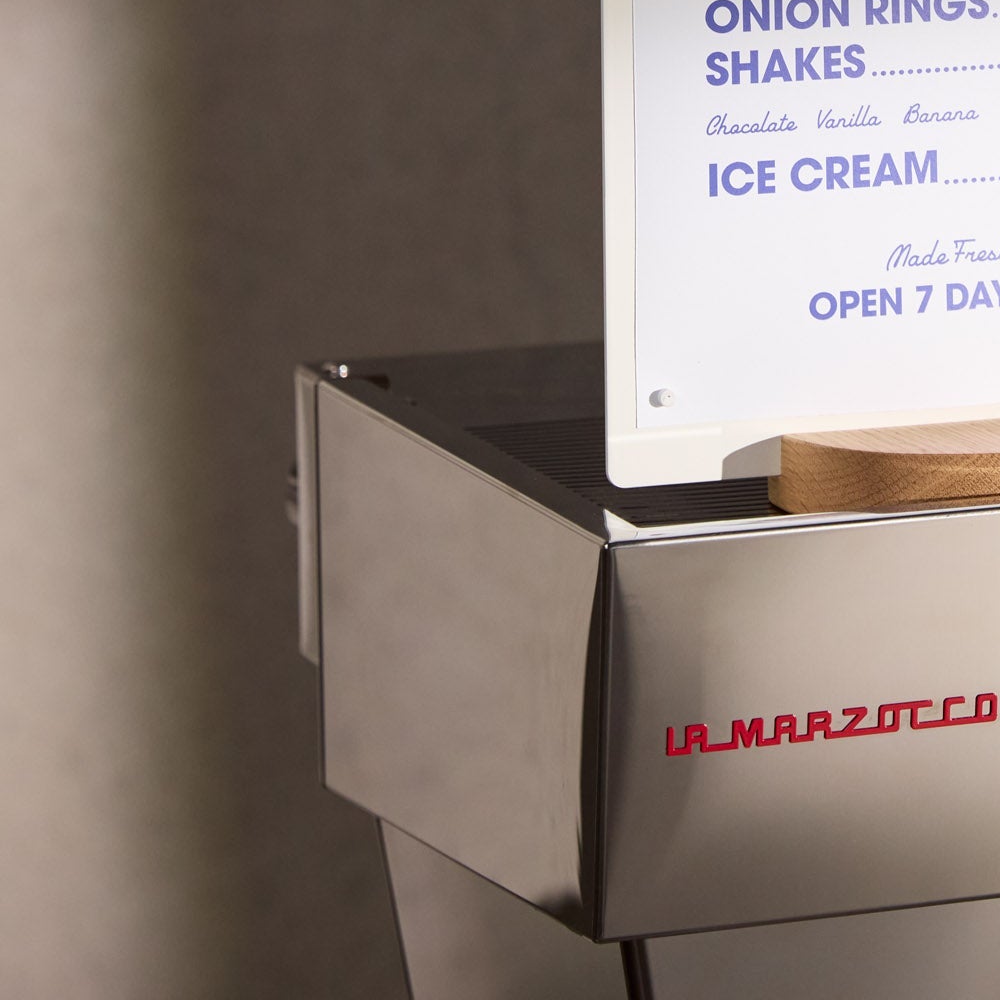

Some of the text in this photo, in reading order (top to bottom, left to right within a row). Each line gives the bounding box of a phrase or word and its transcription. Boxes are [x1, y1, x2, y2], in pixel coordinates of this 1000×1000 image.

[706, 43, 866, 87] SHAKES
[706, 104, 979, 136] Chocolate Vanilla Banana
[708, 160, 776, 197] ICE
[790, 150, 938, 192] CREAM
[886, 240, 950, 269] Made
[809, 287, 903, 321] OPEN
[915, 284, 933, 313] 7
[666, 693, 998, 756] LA MARZOCCO
